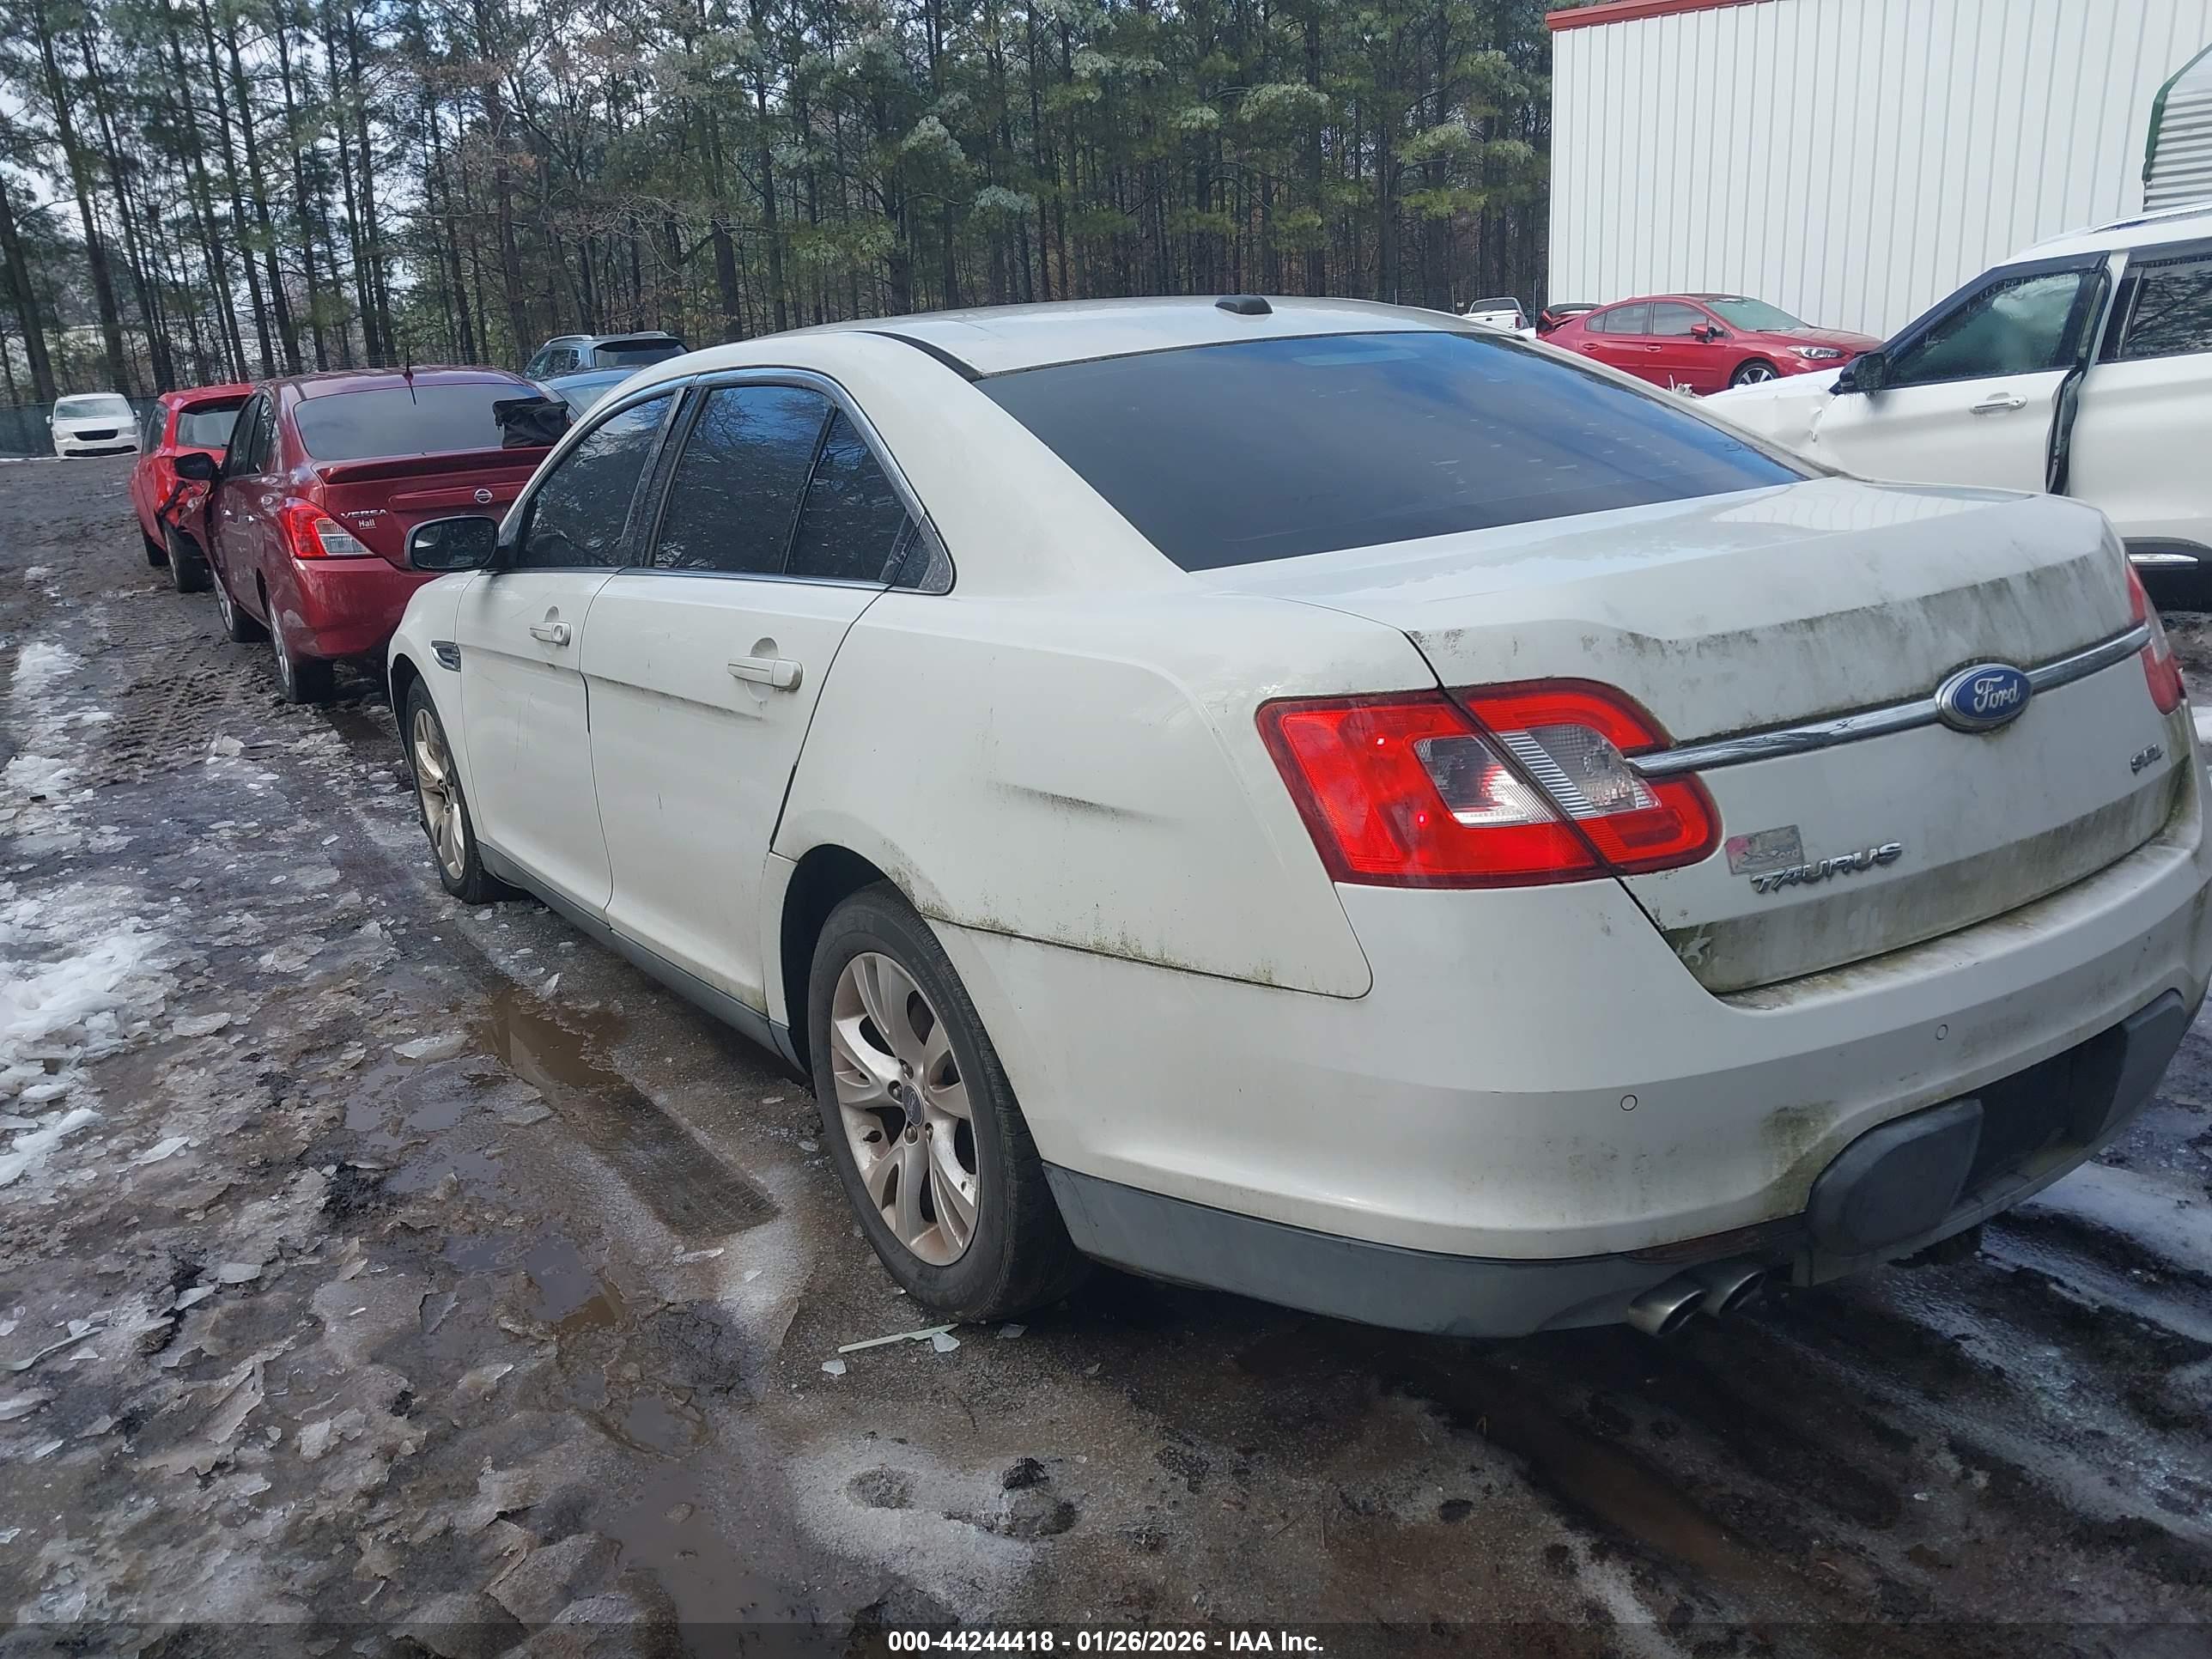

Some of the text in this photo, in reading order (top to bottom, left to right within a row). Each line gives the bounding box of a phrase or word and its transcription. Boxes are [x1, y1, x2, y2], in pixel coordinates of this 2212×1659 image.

[340, 508, 388, 520] VERSA
[358, 519, 376, 529] Hall
[1973, 675, 2020, 713] Ford
[1751, 842, 1902, 893] TAURUS
